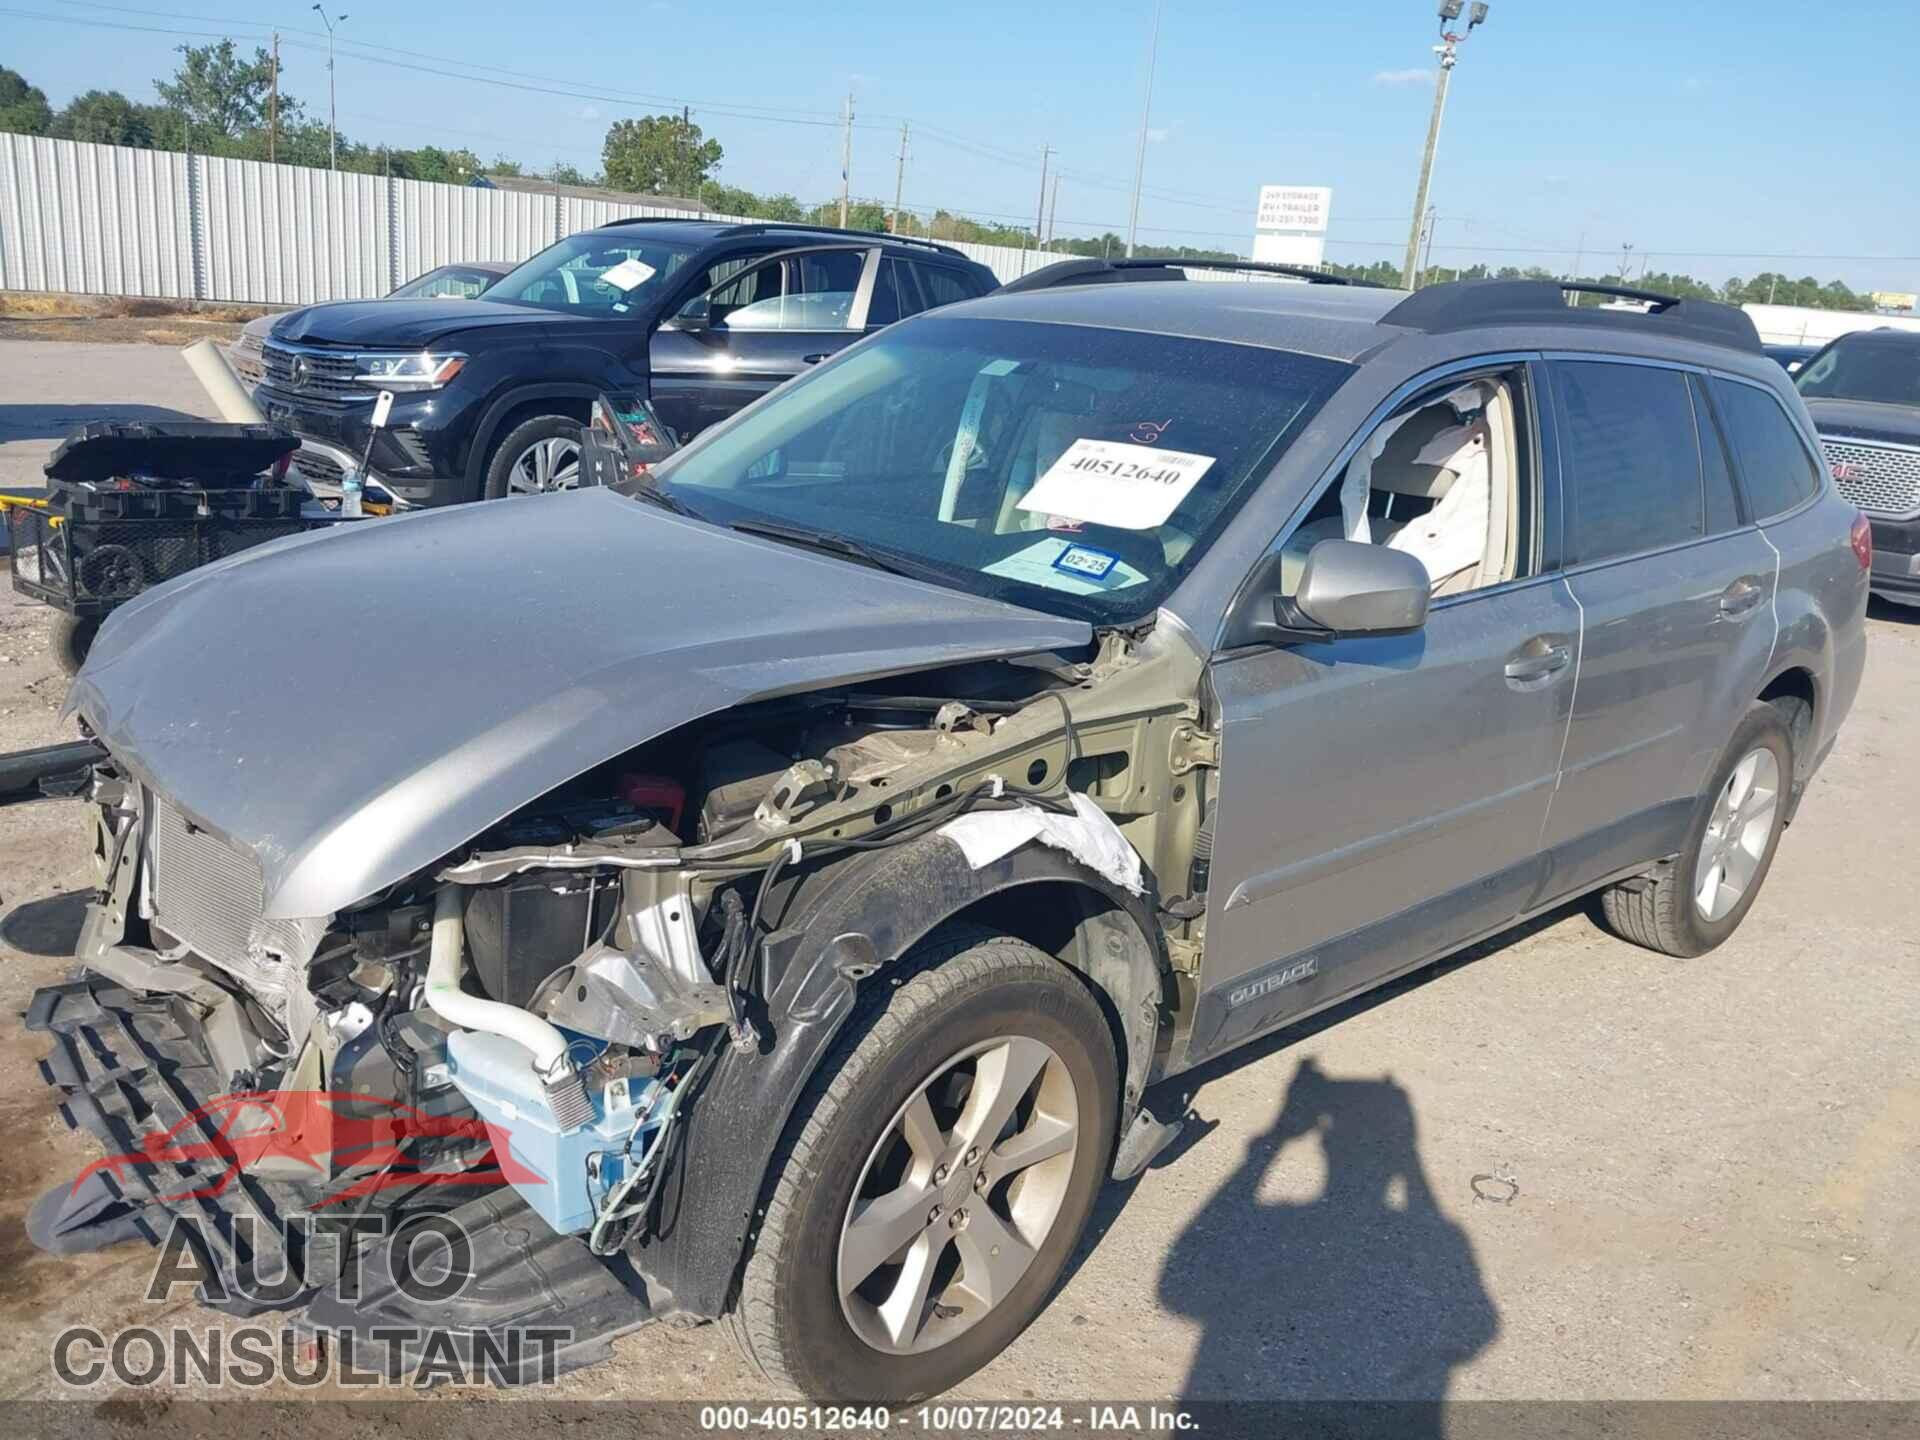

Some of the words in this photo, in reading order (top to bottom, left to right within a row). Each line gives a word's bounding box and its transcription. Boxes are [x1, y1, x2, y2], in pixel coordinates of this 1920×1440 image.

[1282, 203, 1320, 212] TRAILER
[1070, 457, 1181, 485] 40512640
[1230, 959, 1315, 1006] OUTBACK
